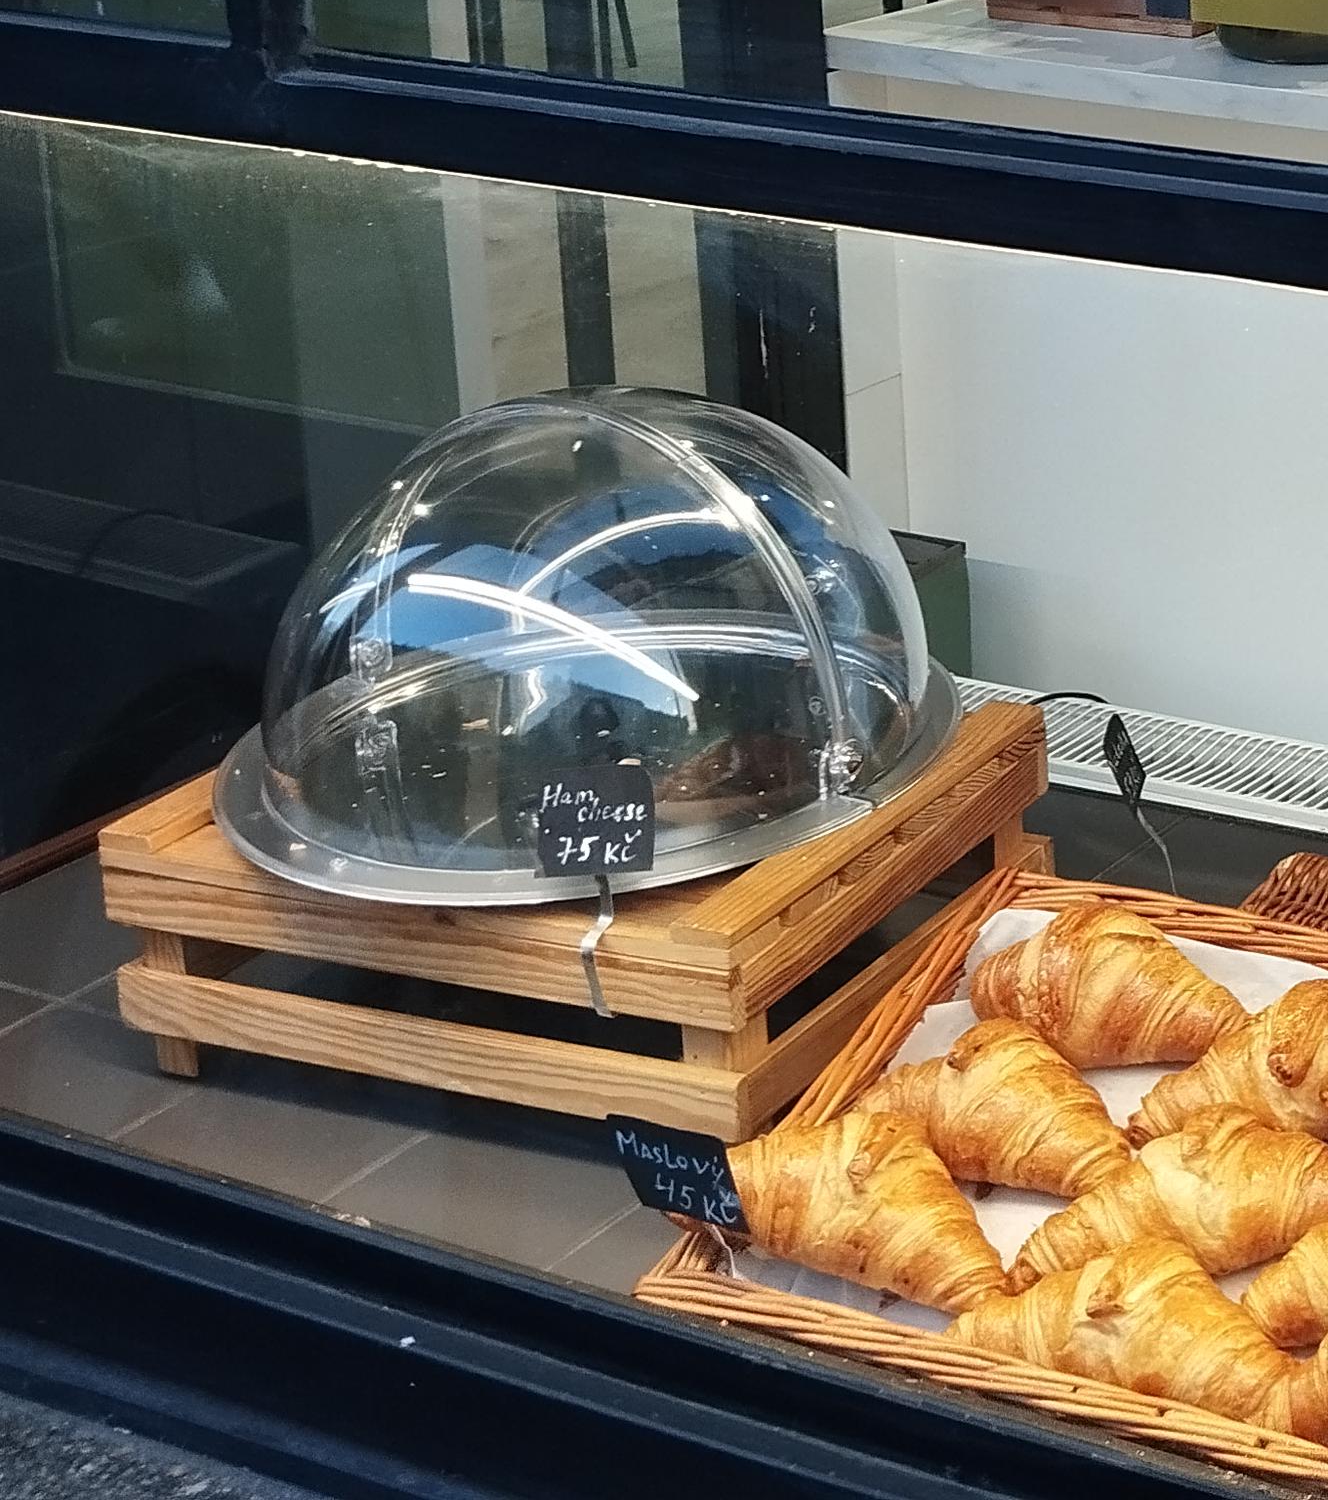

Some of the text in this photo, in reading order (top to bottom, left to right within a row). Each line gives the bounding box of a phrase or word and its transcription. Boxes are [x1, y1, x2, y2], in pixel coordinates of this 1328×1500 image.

[557, 829, 642, 865] 75 Kč
[655, 1173, 697, 1210] 45
